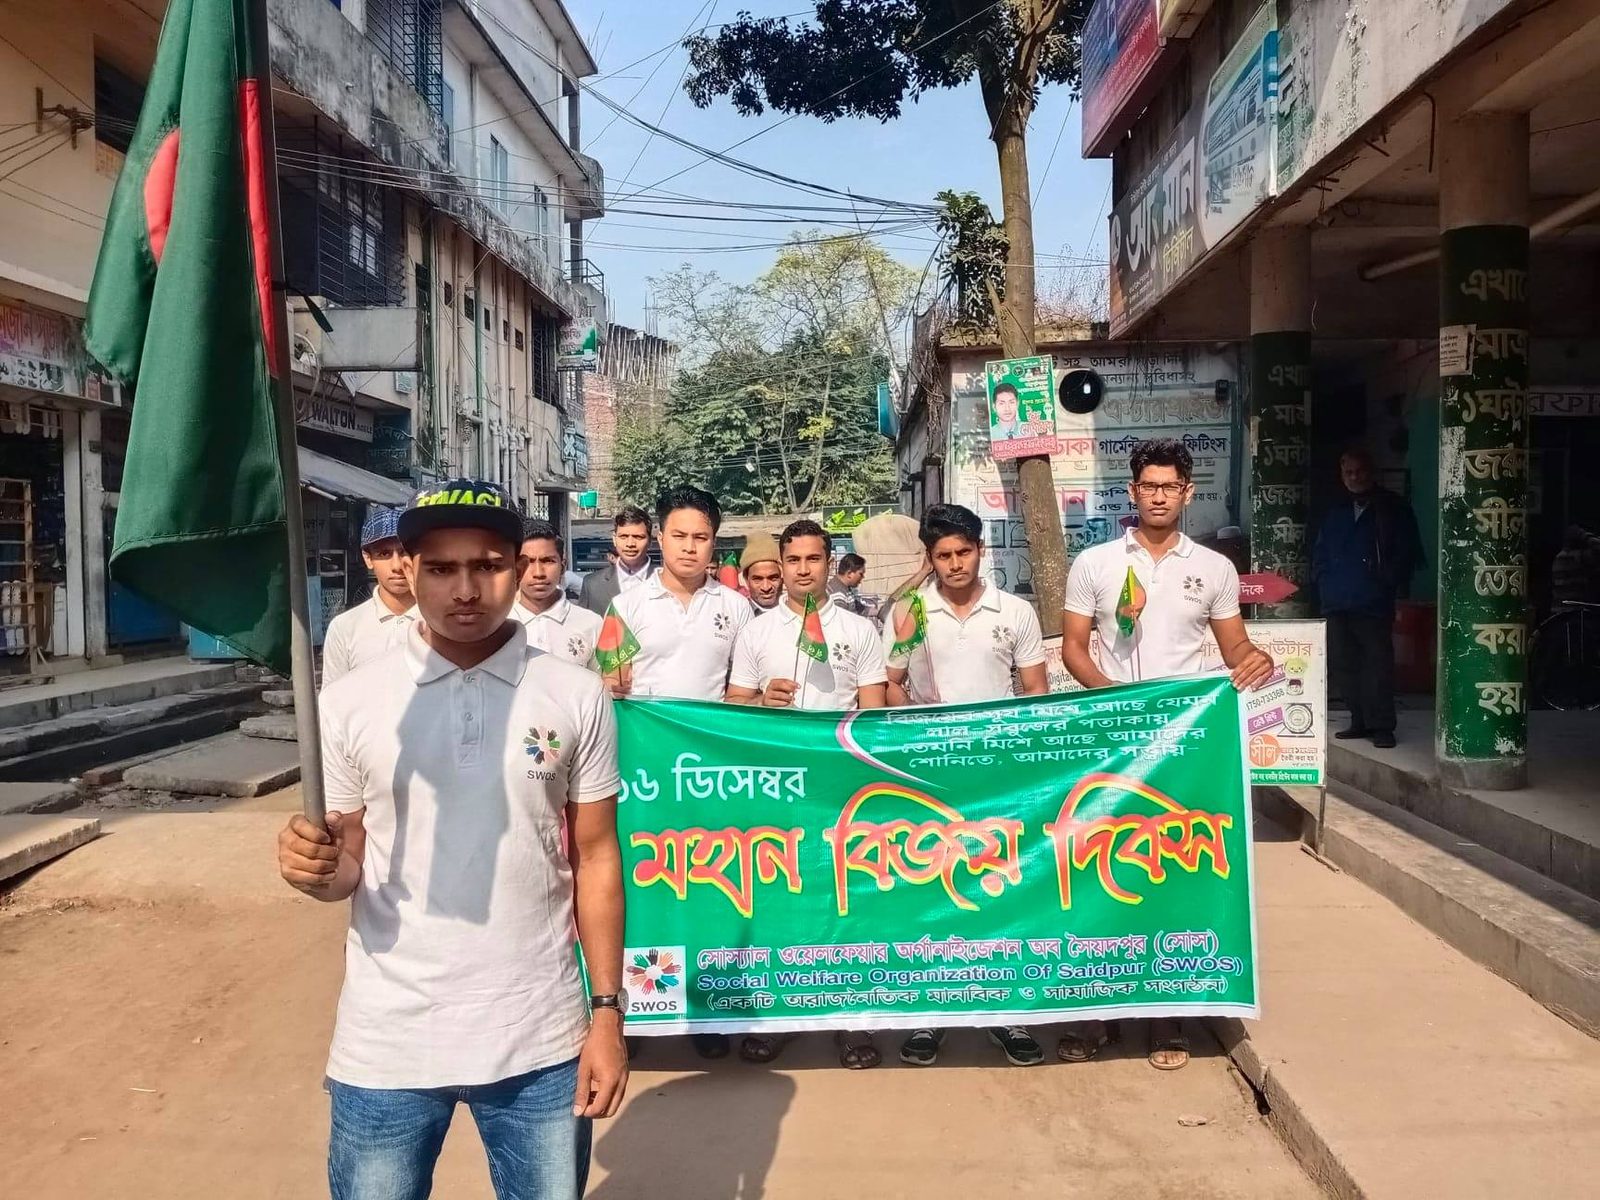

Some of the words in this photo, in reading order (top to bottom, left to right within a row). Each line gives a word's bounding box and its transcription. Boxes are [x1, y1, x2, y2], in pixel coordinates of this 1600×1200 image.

[1183, 433, 1227, 456] ফিটিংস
[1472, 623, 1527, 655] করা
[1091, 696, 1146, 715] আছে
[1078, 713, 1171, 730] পতাকায়
[981, 733, 1032, 751] মিশে
[1041, 731, 1099, 748] আছে
[1106, 726, 1207, 744] আমাদের
[1250, 735, 1277, 767] সীল
[1012, 747, 1111, 764] আমাদের
[527, 768, 557, 781] SWOS
[671, 752, 808, 803] ডিসেম্বর
[630, 826, 806, 919] মহান
[823, 781, 1024, 917] বিজয়
[1043, 773, 1233, 911] দিবস
[893, 934, 1022, 968] অর্গানাইজেশন
[1028, 938, 1063, 959] অব
[1066, 931, 1147, 961] সৈয়দপুর
[697, 971, 769, 991] Social
[776, 970, 863, 988] Welfare
[869, 963, 1017, 986] Organization
[1023, 963, 1052, 980] Of
[1056, 960, 1146, 983] Saidpur
[1152, 956, 1244, 977] (SWOS)
[630, 999, 678, 1013] SWOS
[706, 991, 775, 1011] (একটি
[783, 986, 920, 1010] অরাজনৈতিক
[1018, 987, 1037, 1000] ও
[1043, 979, 1138, 1000] সামাজিক
[1144, 974, 1229, 994] সংগঠন)
